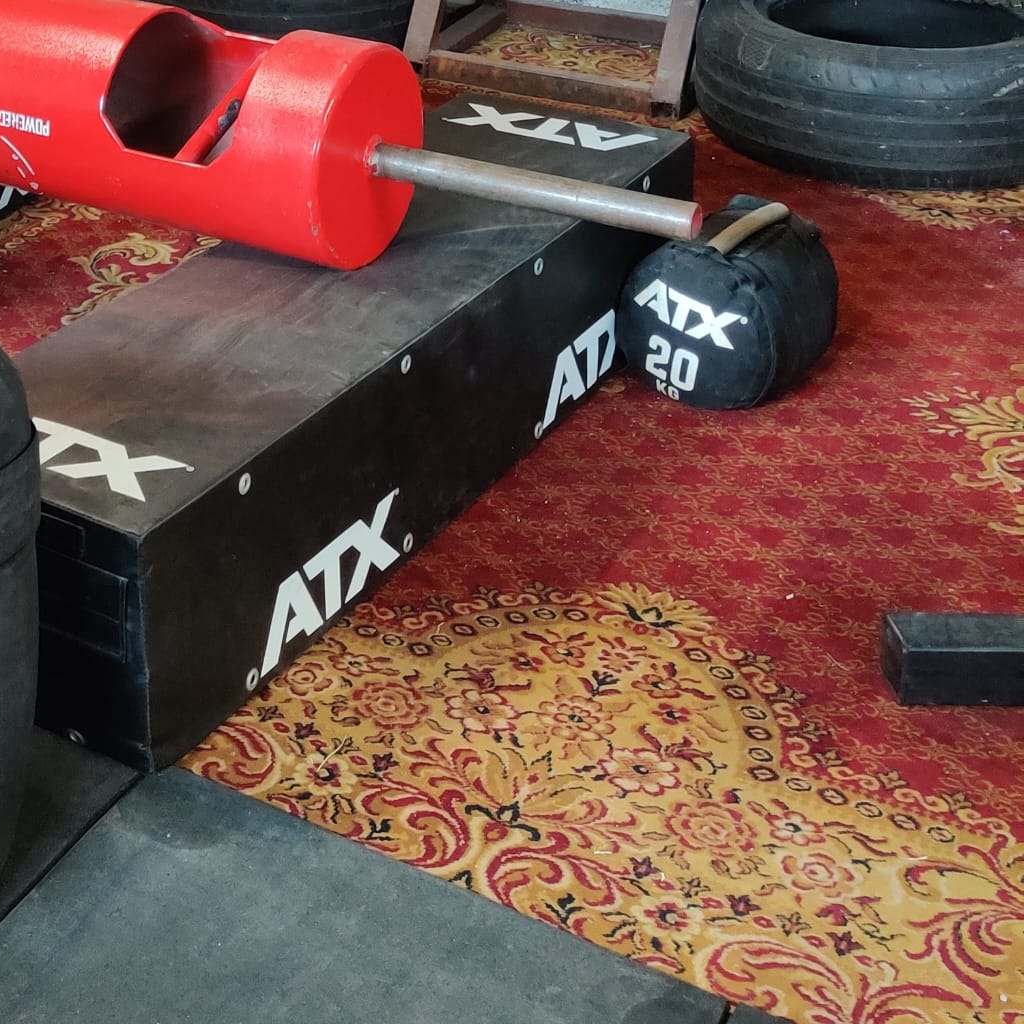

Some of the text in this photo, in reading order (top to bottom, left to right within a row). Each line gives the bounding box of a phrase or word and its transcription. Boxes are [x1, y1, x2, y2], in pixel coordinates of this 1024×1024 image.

[442, 103, 659, 152] ATX
[633, 278, 743, 350] ATX
[645, 334, 699, 392] 20
[655, 379, 680, 401] KG
[31, 416, 188, 502] TX
[260, 487, 401, 678] ATX
